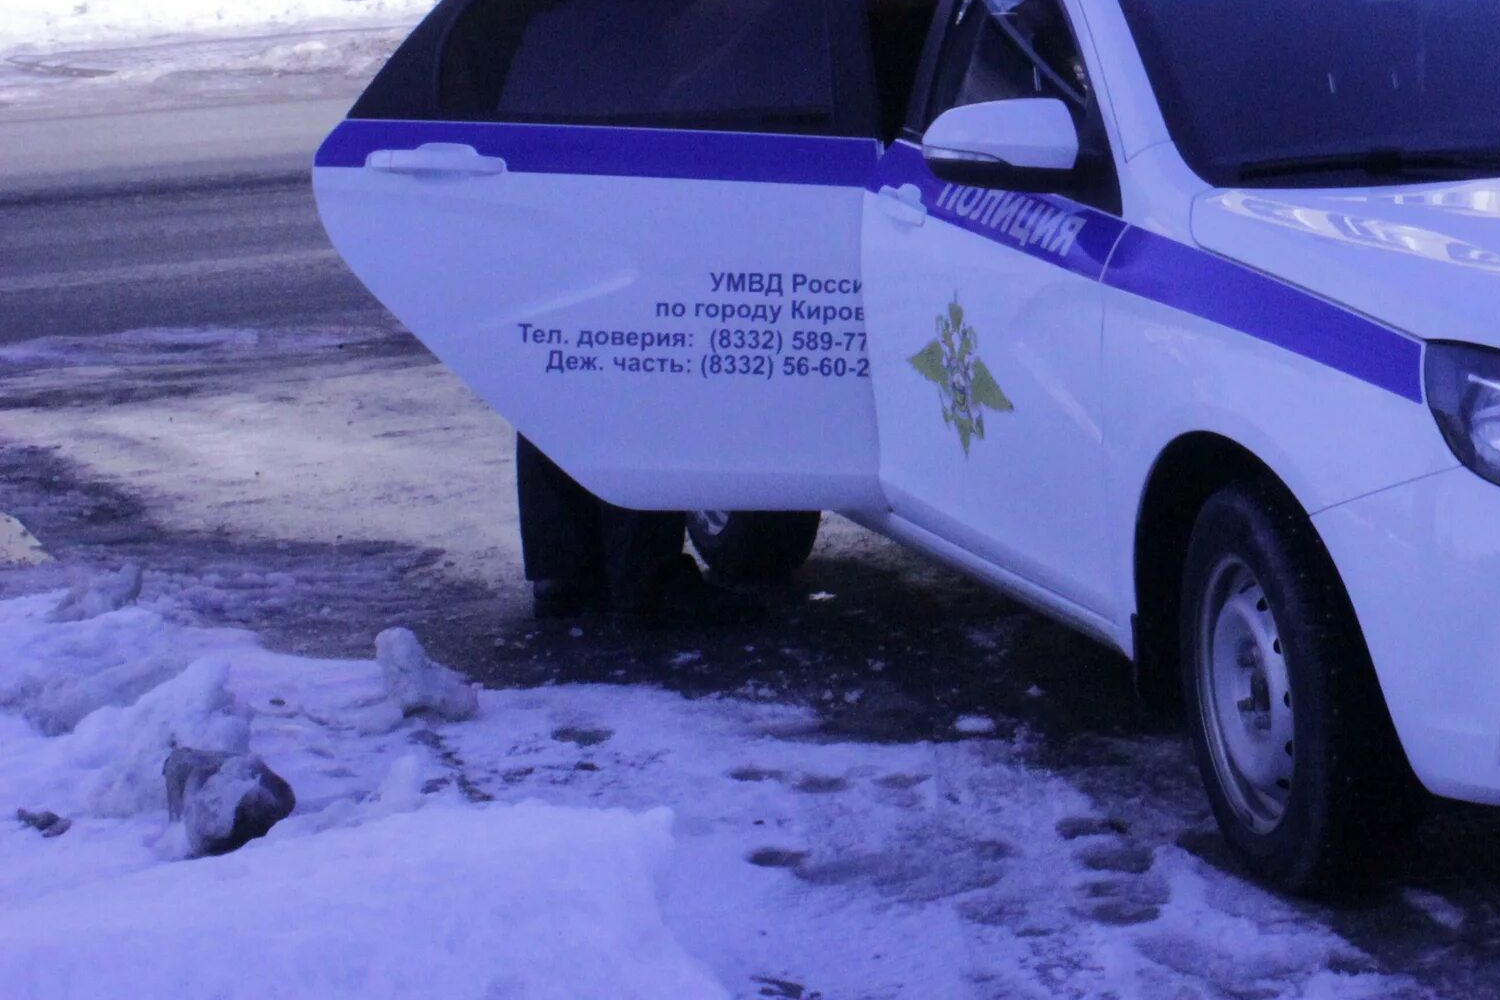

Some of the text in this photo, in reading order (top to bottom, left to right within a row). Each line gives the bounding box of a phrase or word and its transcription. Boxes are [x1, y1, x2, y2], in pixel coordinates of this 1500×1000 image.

[936, 183, 1087, 257] ПОЛИЦИЯ
[710, 272, 784, 297] УМВД
[656, 302, 686, 318] по
[695, 302, 782, 324] городу
[518, 323, 569, 345] Тел.
[576, 330, 694, 351] доверия:
[710, 328, 783, 355] (8332)
[545, 350, 869, 379] Деж. часть: (8332) 56-60-2
